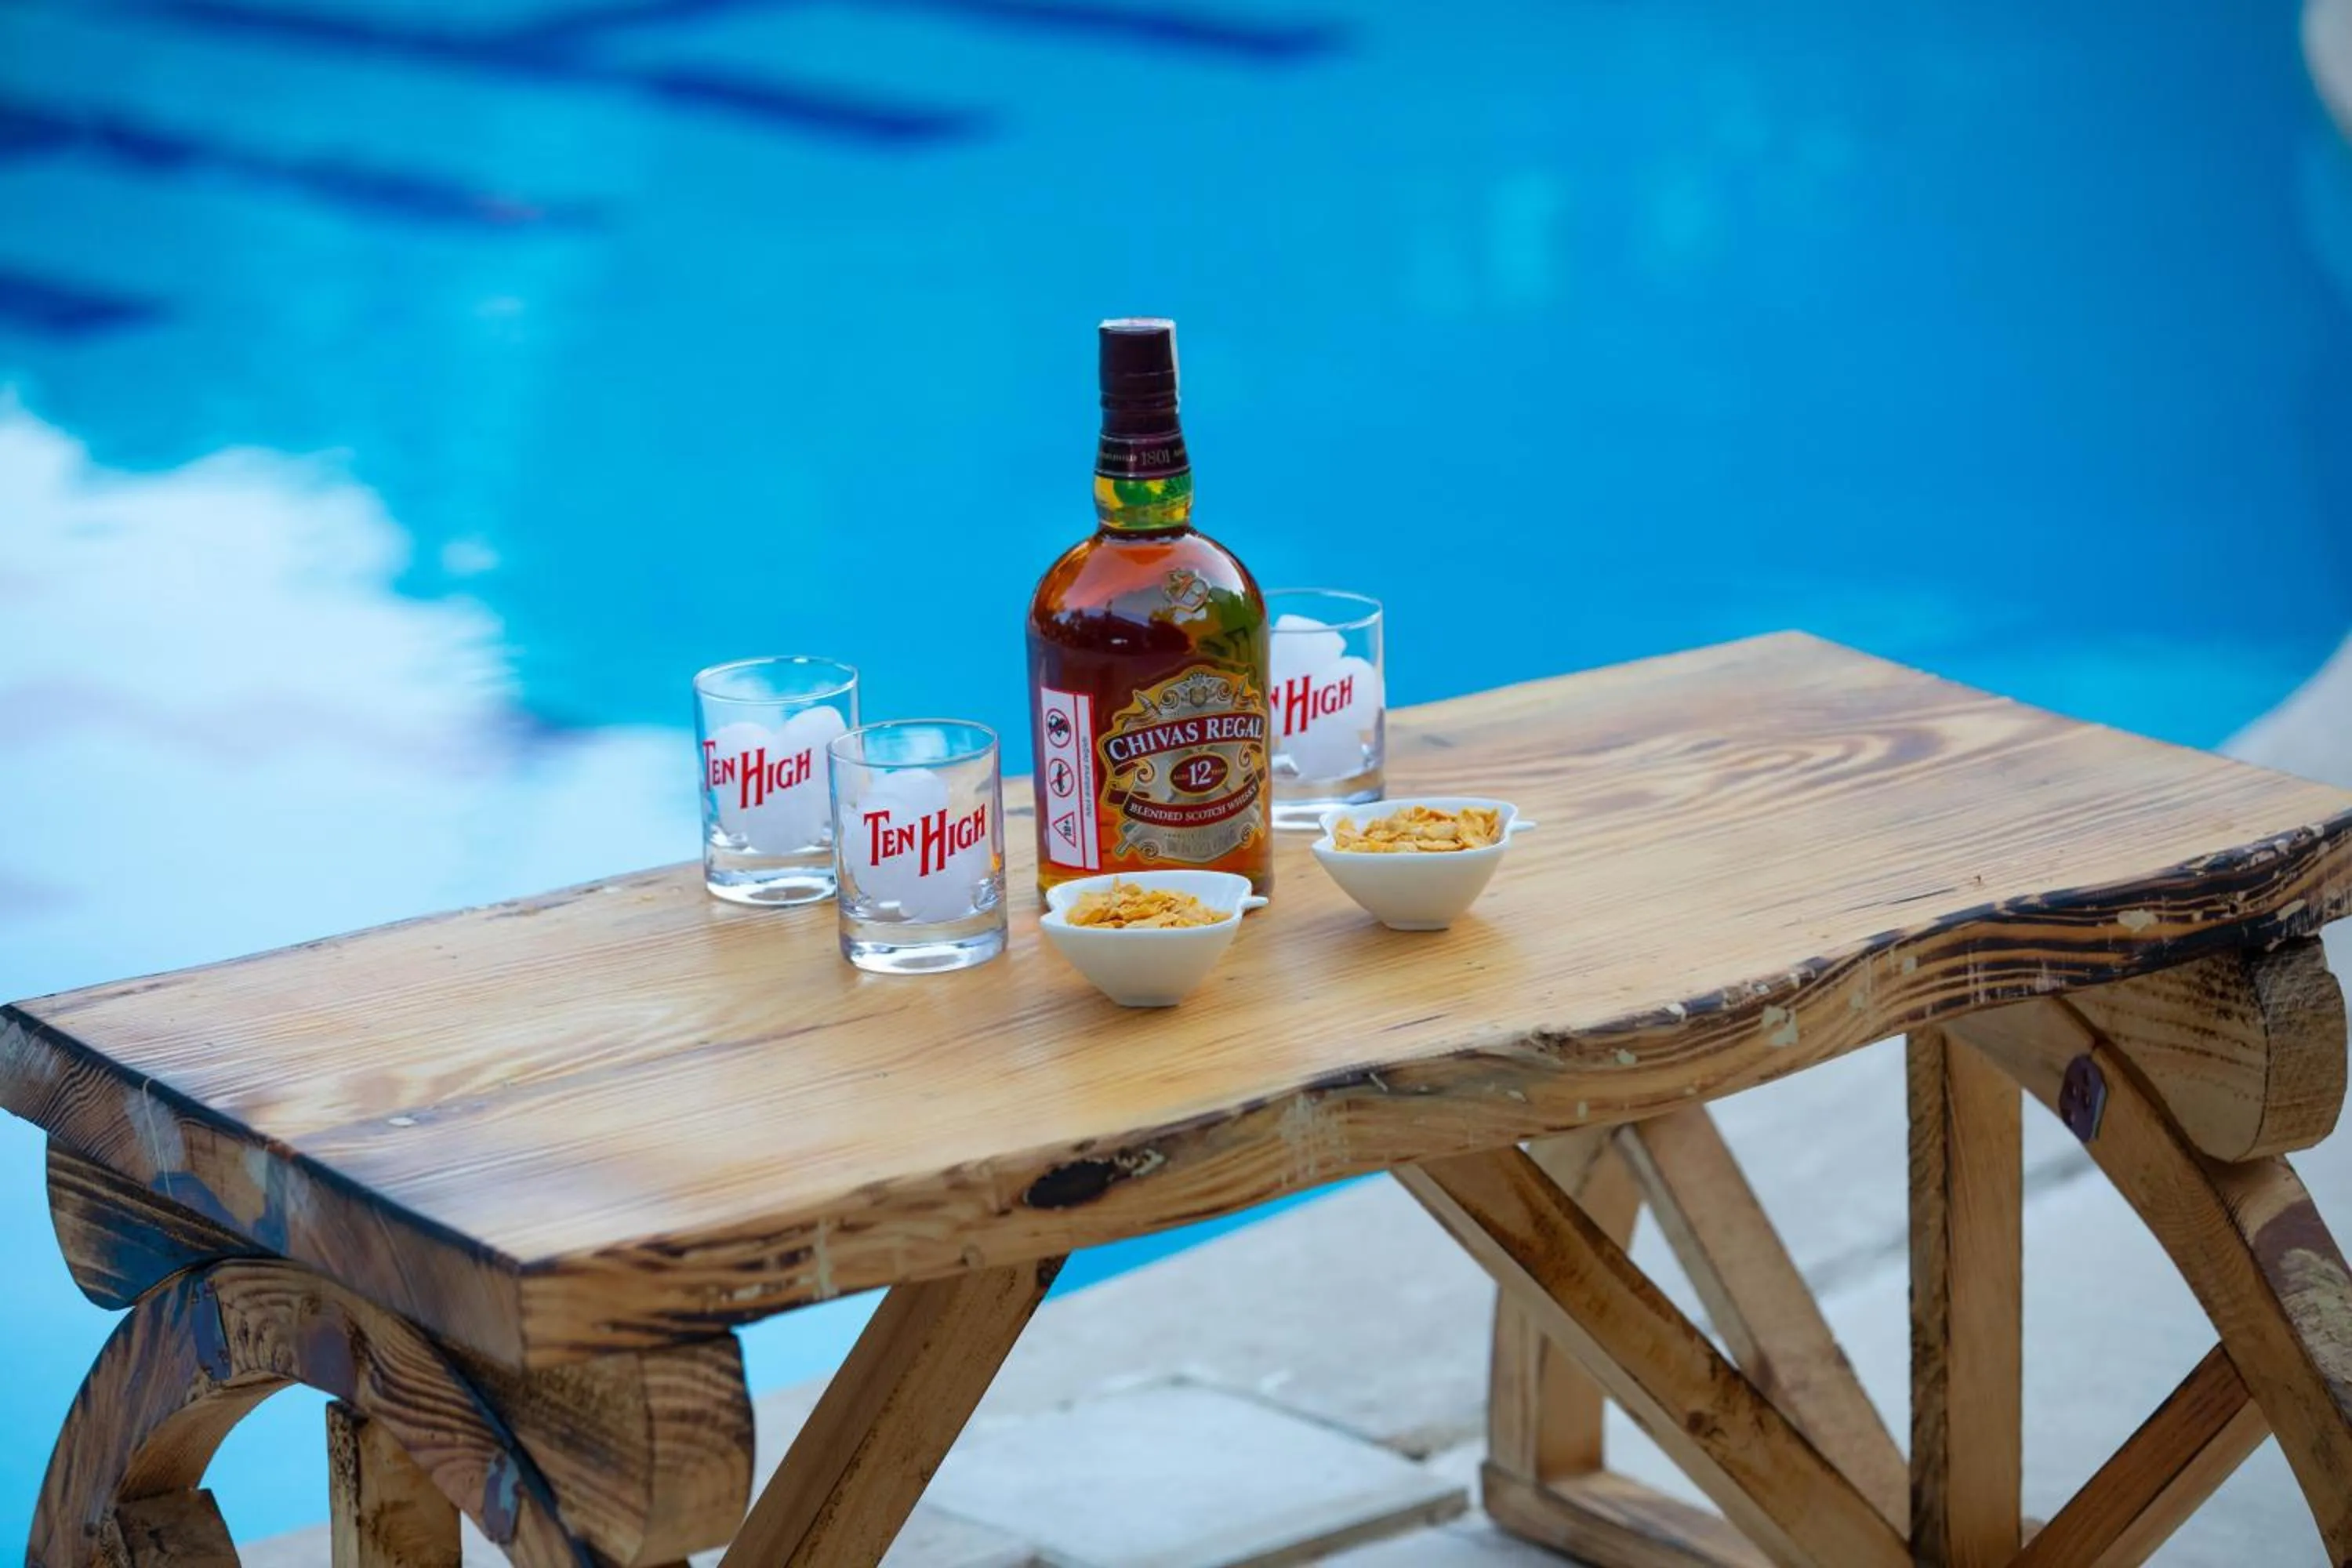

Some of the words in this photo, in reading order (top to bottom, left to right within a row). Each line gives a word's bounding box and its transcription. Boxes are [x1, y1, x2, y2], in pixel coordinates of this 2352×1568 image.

[1140, 448, 1171, 466] 1801
[1283, 675, 1354, 736] HIGH
[1109, 722, 1199, 761] CHIVAS
[1205, 716, 1263, 741] REGAL
[702, 741, 735, 793] TEN
[739, 748, 812, 809] HIGH
[1189, 760, 1212, 786] 12
[1128, 802, 1184, 822] BLENDED
[1185, 805, 1225, 822] SCOTCH
[864, 810, 916, 866] TEN
[919, 804, 986, 877] HIGH
